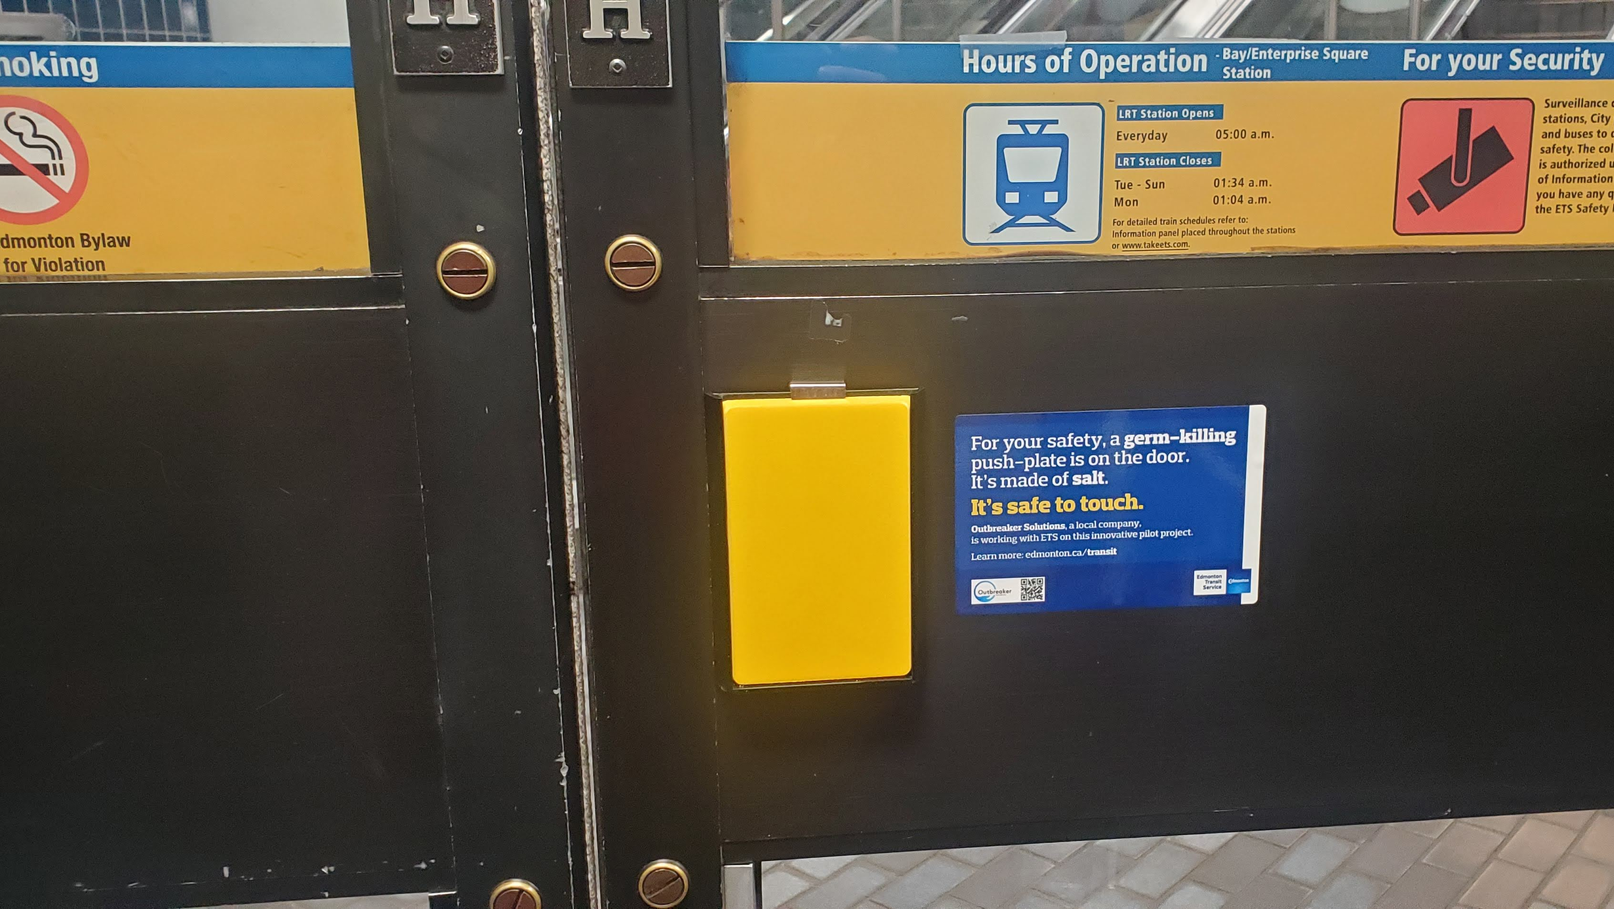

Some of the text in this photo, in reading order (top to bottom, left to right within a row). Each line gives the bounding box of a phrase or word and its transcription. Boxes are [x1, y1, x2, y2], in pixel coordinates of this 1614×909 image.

[1222, 47, 1319, 63] Bay/Enterprise
[1322, 47, 1369, 63] Square
[963, 47, 1208, 79] Hours of Operation
[1403, 47, 1605, 77] For your Security
[1222, 66, 1271, 79] Station
[1544, 98, 1608, 109] Surveillance
[1119, 107, 1214, 120] LRT Station Opens
[1543, 113, 1611, 126] stations, City
[1116, 129, 1275, 143] Everyday 05:00 a.m.
[1541, 128, 1561, 139] and
[1564, 128, 1593, 139] buses
[1597, 129, 1608, 138] to
[1540, 143, 1575, 156] safety.
[1578, 143, 1596, 154] The
[1117, 156, 1213, 167] LRT Station Closes
[1539, 159, 1547, 169] is
[1550, 158, 1606, 169] authorized
[1114, 180, 1133, 190] Tue
[1145, 179, 1165, 190] Sun
[1213, 178, 1244, 188] 01:34
[1248, 178, 1272, 188] a.m.
[1537, 173, 1613, 184] of Information
[1114, 195, 1271, 207] Mon 01:04 a.m.
[1536, 191, 1555, 202] you
[1558, 189, 1583, 199] have
[1586, 190, 1605, 201] any
[1535, 204, 1552, 214] the
[1555, 204, 1573, 214] ETS
[1575, 203, 1609, 216] Safety
[1112, 215, 1249, 227] For detailed train schedules refer to:
[1112, 225, 1296, 239] Information panel placed throughout the stations
[0, 232, 131, 251] dmonton Bylaw
[1122, 240, 1190, 250] www.takeets.com.
[3, 256, 106, 273] for Violation
[971, 428, 1236, 453] For your safety, a germ-killing
[971, 449, 1190, 474] push-plate is on the door.
[971, 470, 1109, 489] It's made of salt.
[971, 493, 1144, 516] It's safe to touch.
[971, 523, 1022, 534] Outbreaker
[1023, 521, 1068, 532] Solutions,
[1069, 522, 1075, 530] a
[1076, 520, 1097, 530] local
[971, 536, 979, 545] is
[980, 535, 1018, 545] working
[1019, 533, 1039, 543] with
[1040, 533, 1058, 542] ETS
[1072, 531, 1090, 541] this
[1091, 530, 1138, 540] innovative
[1139, 529, 1159, 540] pilot
[1160, 528, 1194, 539] project.
[971, 546, 1118, 561] Learn more: edmonton.ca/transit
[977, 588, 1012, 596] Outbreaker
